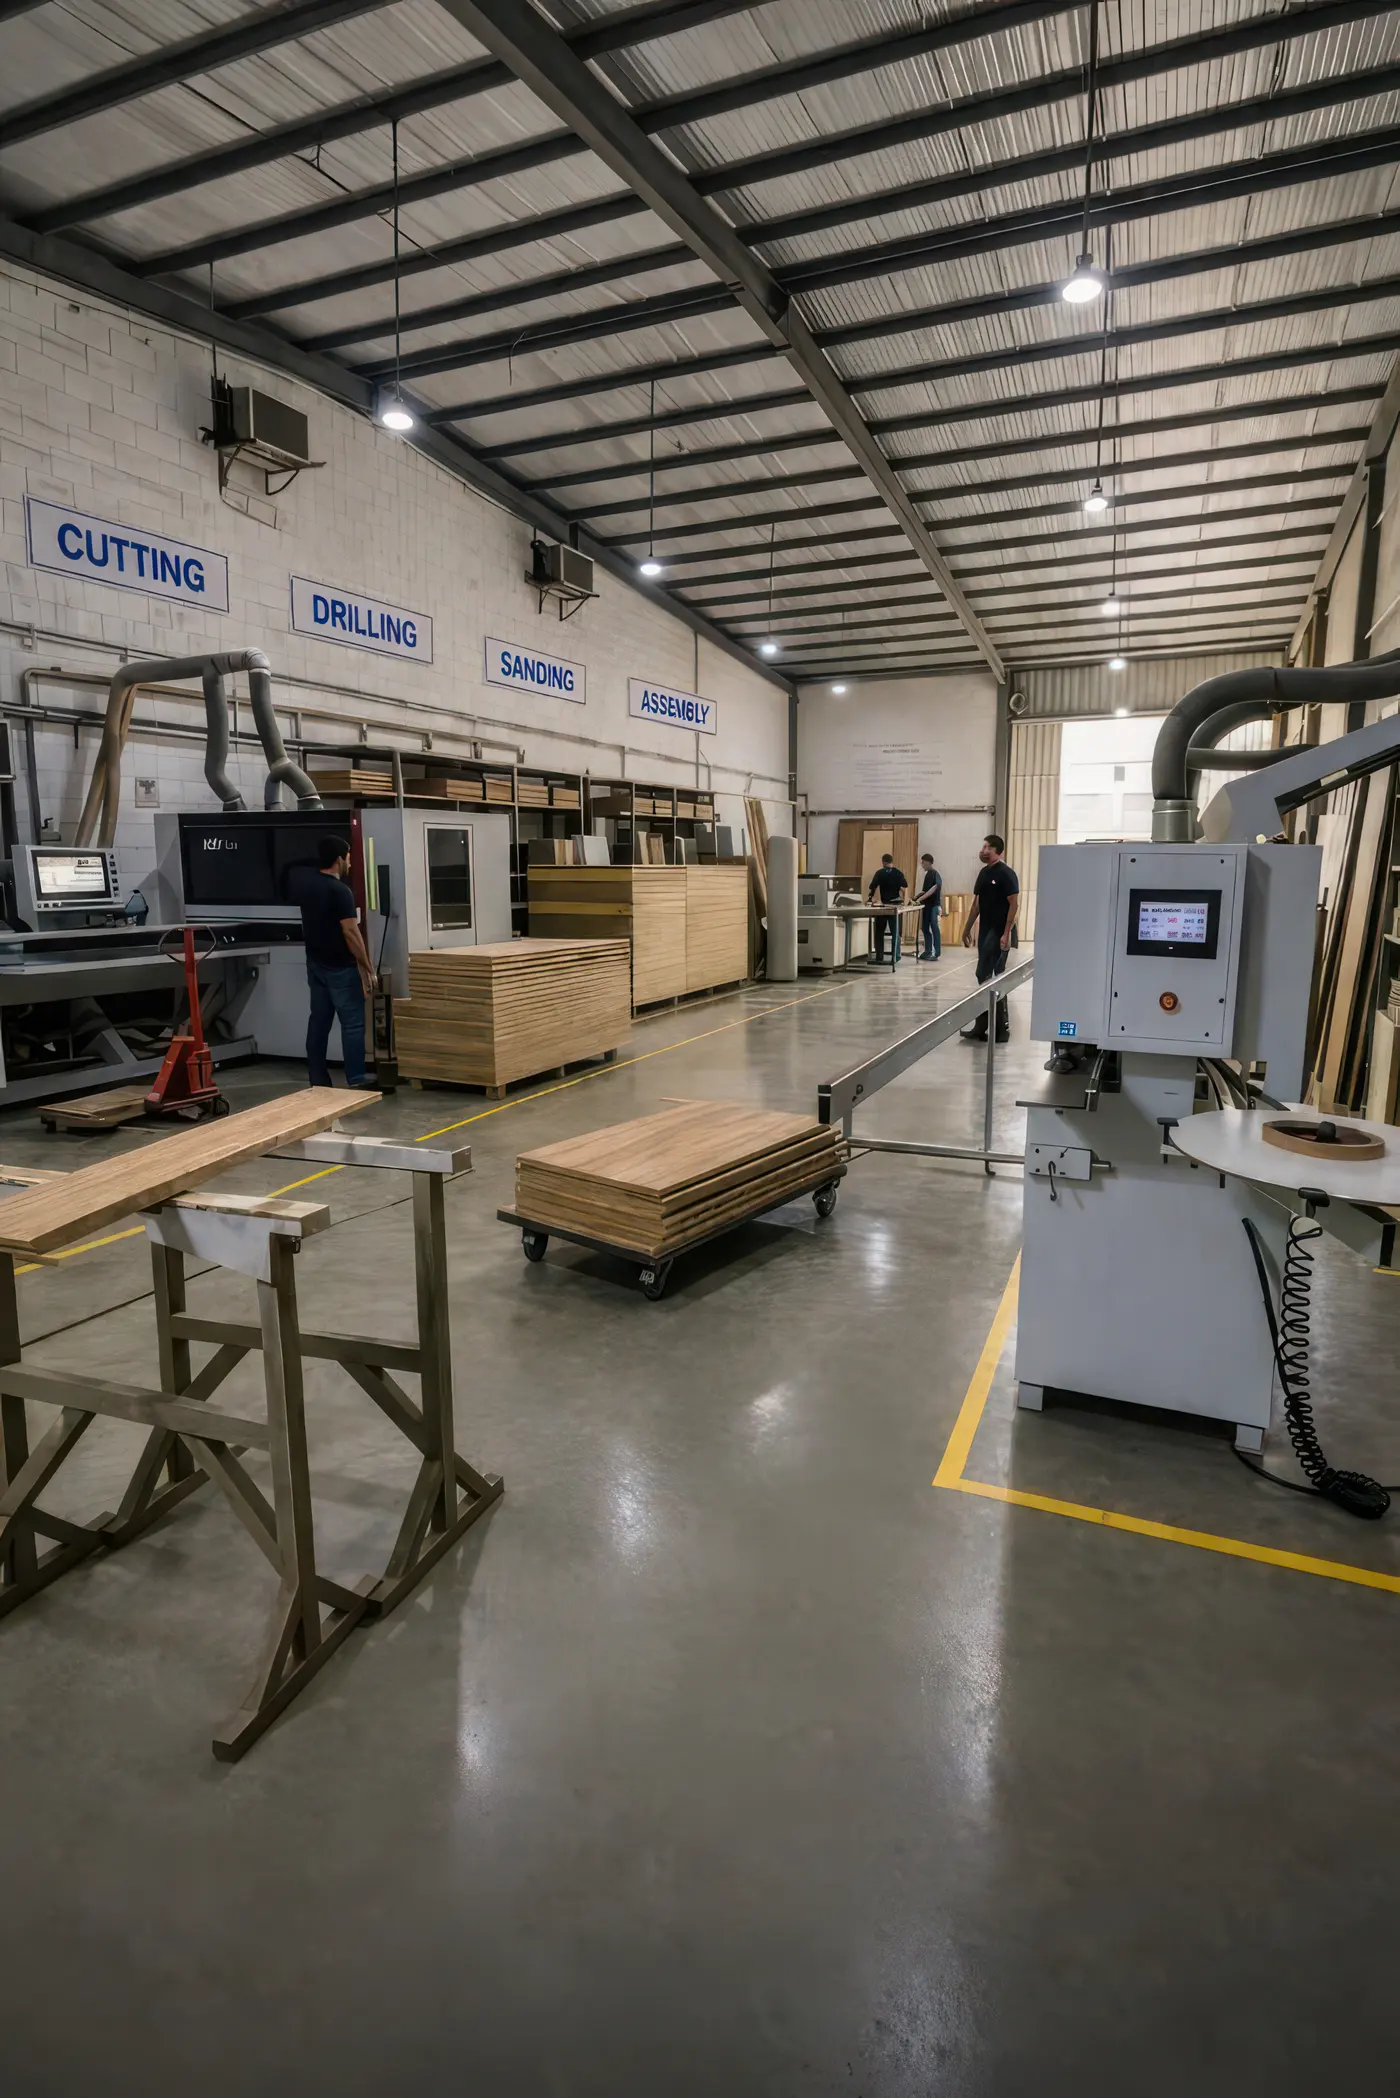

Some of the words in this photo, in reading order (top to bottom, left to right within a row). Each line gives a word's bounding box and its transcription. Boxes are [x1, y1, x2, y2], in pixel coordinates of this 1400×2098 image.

[57, 523, 205, 592] CUTTING
[313, 594, 417, 648] DRILLING
[501, 651, 574, 691] SANDING
[641, 690, 710, 724] ASSEMBLY
